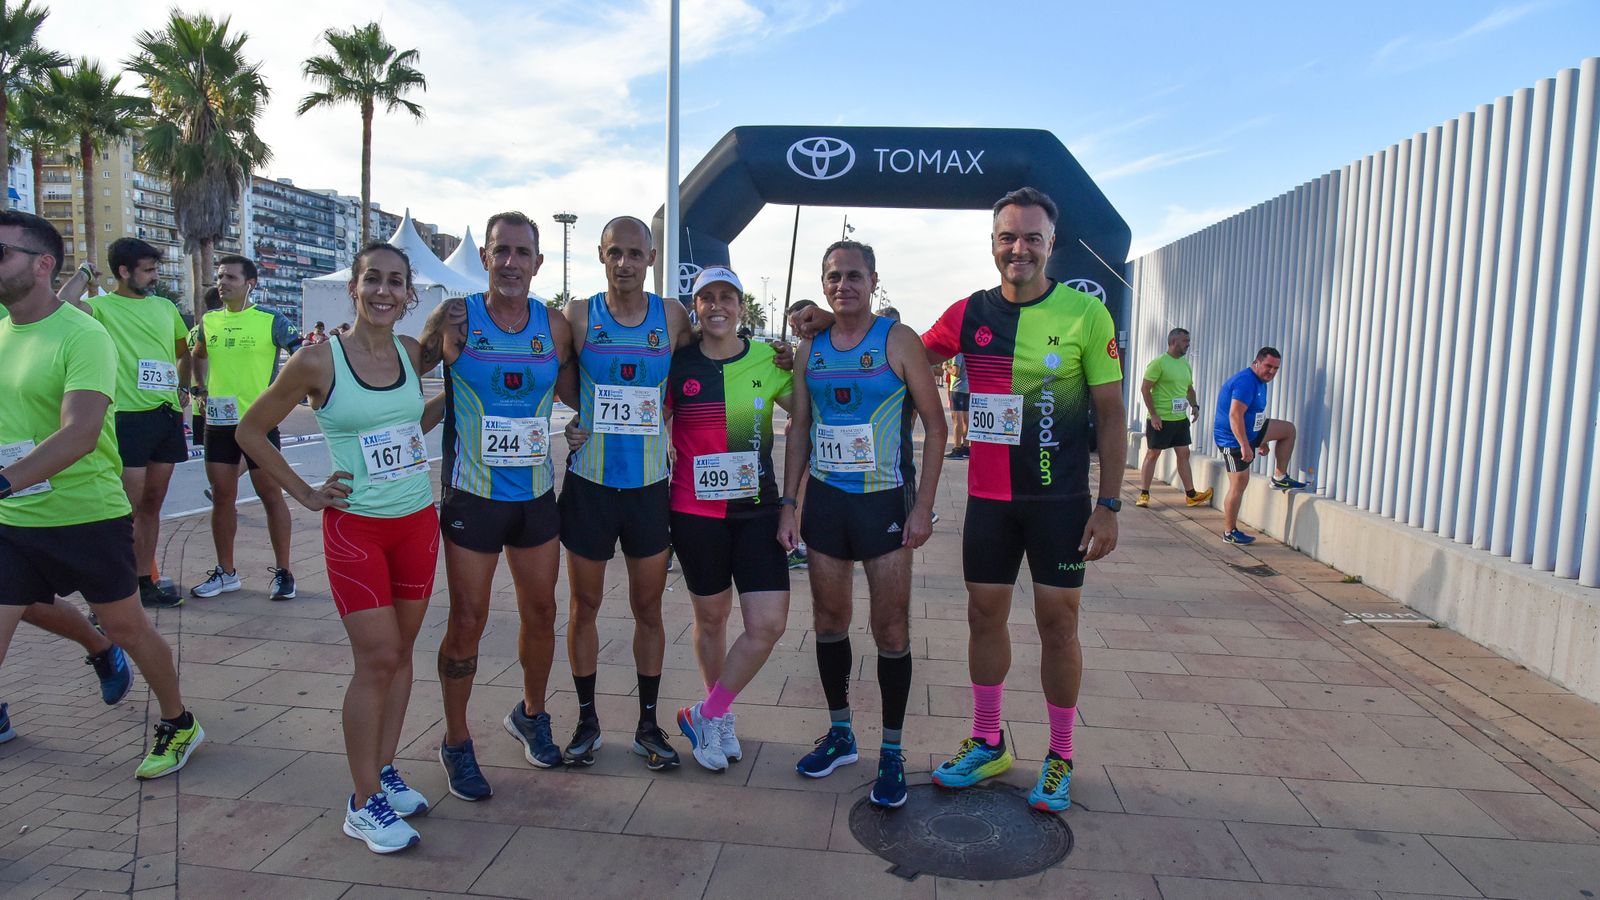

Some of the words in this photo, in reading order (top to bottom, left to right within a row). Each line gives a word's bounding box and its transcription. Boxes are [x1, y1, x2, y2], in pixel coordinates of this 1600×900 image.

[873, 148, 985, 174] TOMAX
[142, 370, 162, 382] 573
[598, 389, 610, 397] XXI
[600, 402, 631, 421] 713
[973, 410, 995, 429] 500
[485, 420, 498, 428] XXI
[362, 435, 378, 446] XXI
[487, 434, 520, 453] 244
[371, 444, 401, 469] 167
[820, 441, 842, 459] 111
[696, 458, 708, 466] XXI
[699, 469, 729, 488] 499
